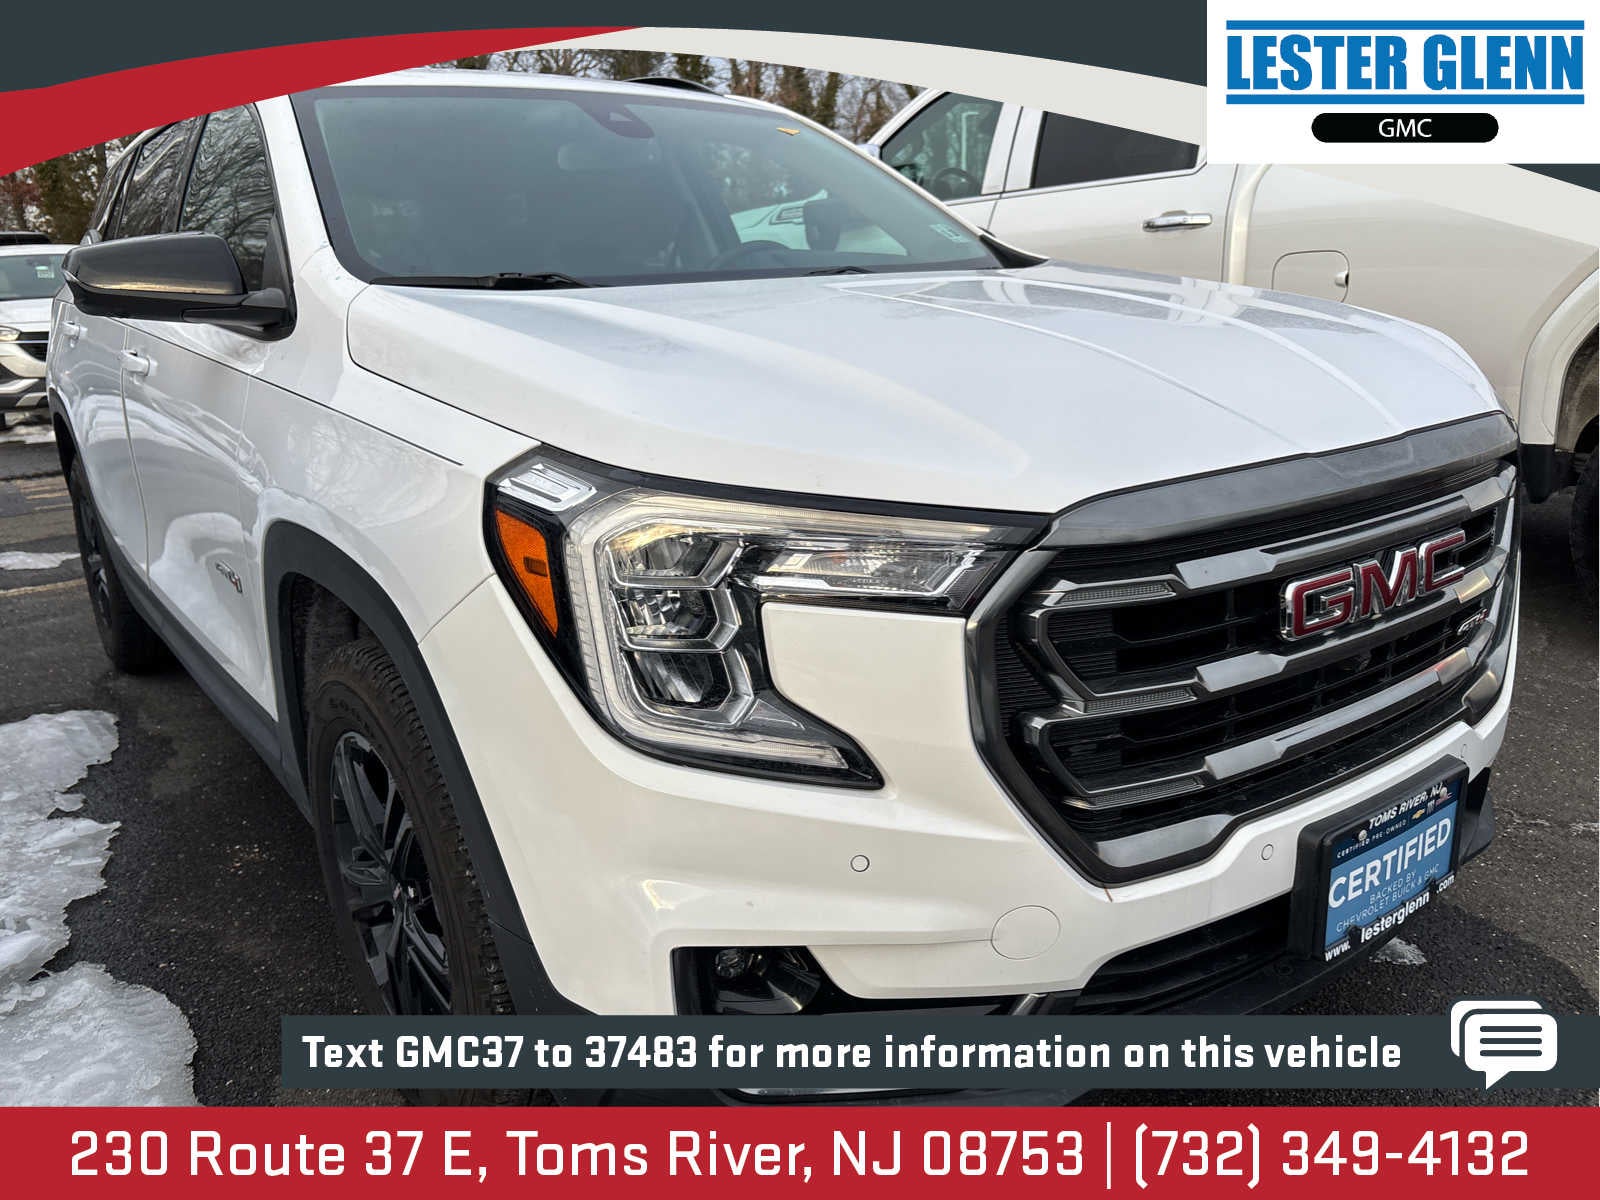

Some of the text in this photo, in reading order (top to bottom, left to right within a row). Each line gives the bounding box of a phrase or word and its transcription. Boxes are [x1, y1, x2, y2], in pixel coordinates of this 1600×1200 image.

[1281, 529, 1466, 642] GMC
[1369, 806, 1398, 830] TOMS
[1399, 791, 1429, 815] RIVER,
[1430, 782, 1444, 798] NJ
[1328, 818, 1451, 909] CERTIFIED
[1337, 838, 1370, 859] CERTIFIED
[1369, 869, 1417, 905] BACKED BY
[1392, 882, 1416, 902] BUICK
[1324, 874, 1455, 962] www. lesterglenn .com
